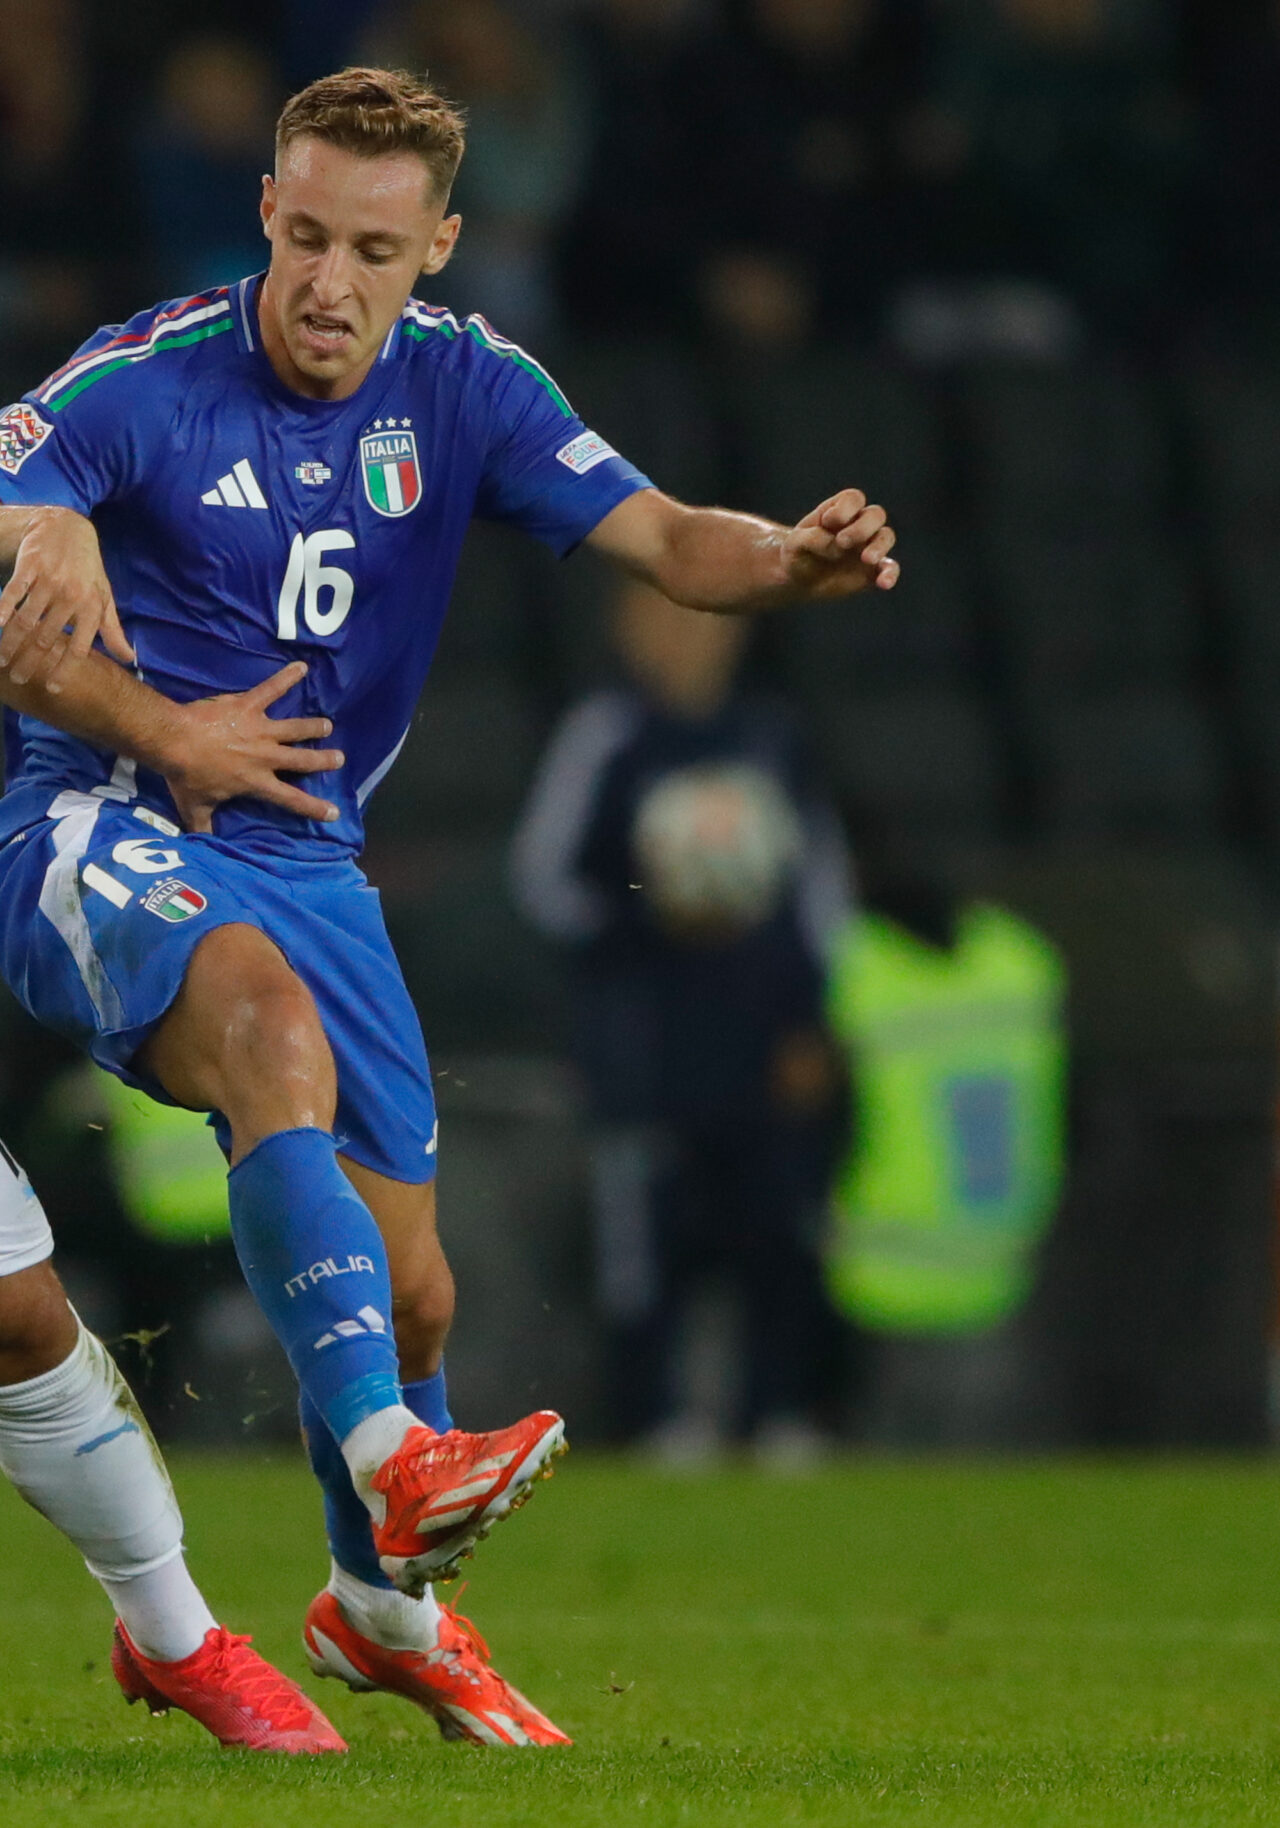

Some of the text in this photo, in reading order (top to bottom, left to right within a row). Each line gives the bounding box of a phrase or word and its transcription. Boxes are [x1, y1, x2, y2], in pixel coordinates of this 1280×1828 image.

[364, 438, 412, 459] ITALIA
[277, 529, 356, 640] 16
[82, 838, 185, 910] 16
[149, 883, 183, 909] ITALIA
[284, 1255, 375, 1298] ITALIA
